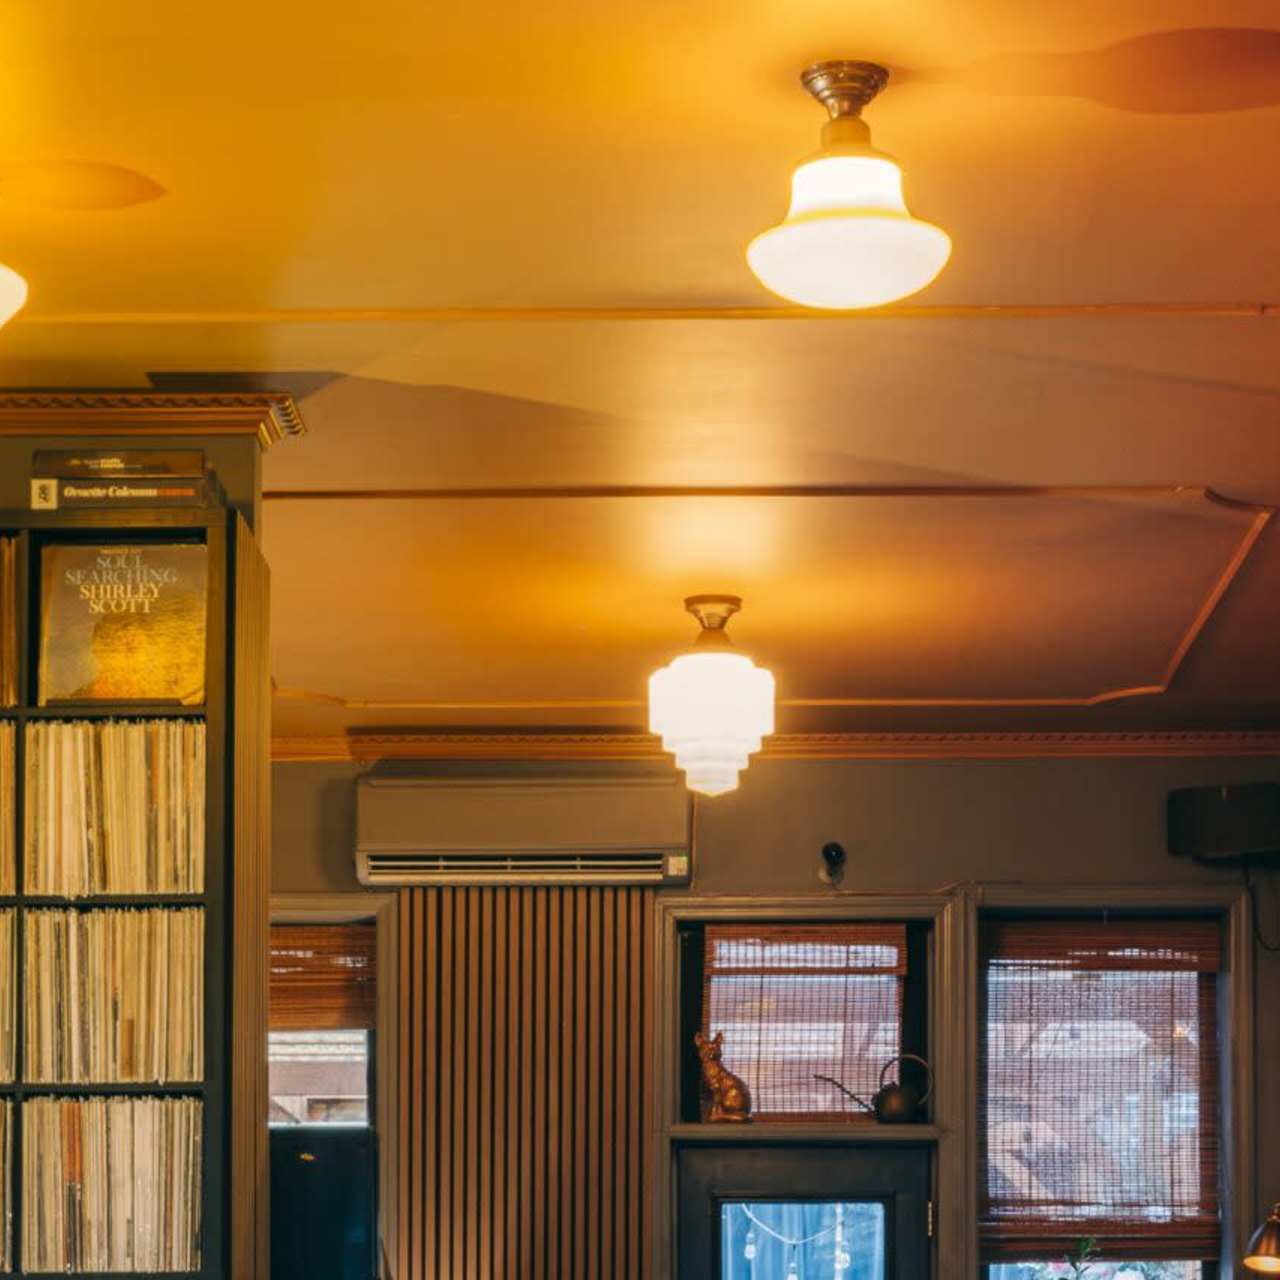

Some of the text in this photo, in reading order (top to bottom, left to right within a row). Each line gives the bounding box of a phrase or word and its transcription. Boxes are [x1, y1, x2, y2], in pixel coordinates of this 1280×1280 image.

[96, 555, 146, 569] SOUL
[65, 568, 177, 585] SEARCHING
[80, 583, 162, 599] SHIRLEY
[88, 598, 156, 614] SCOTT
